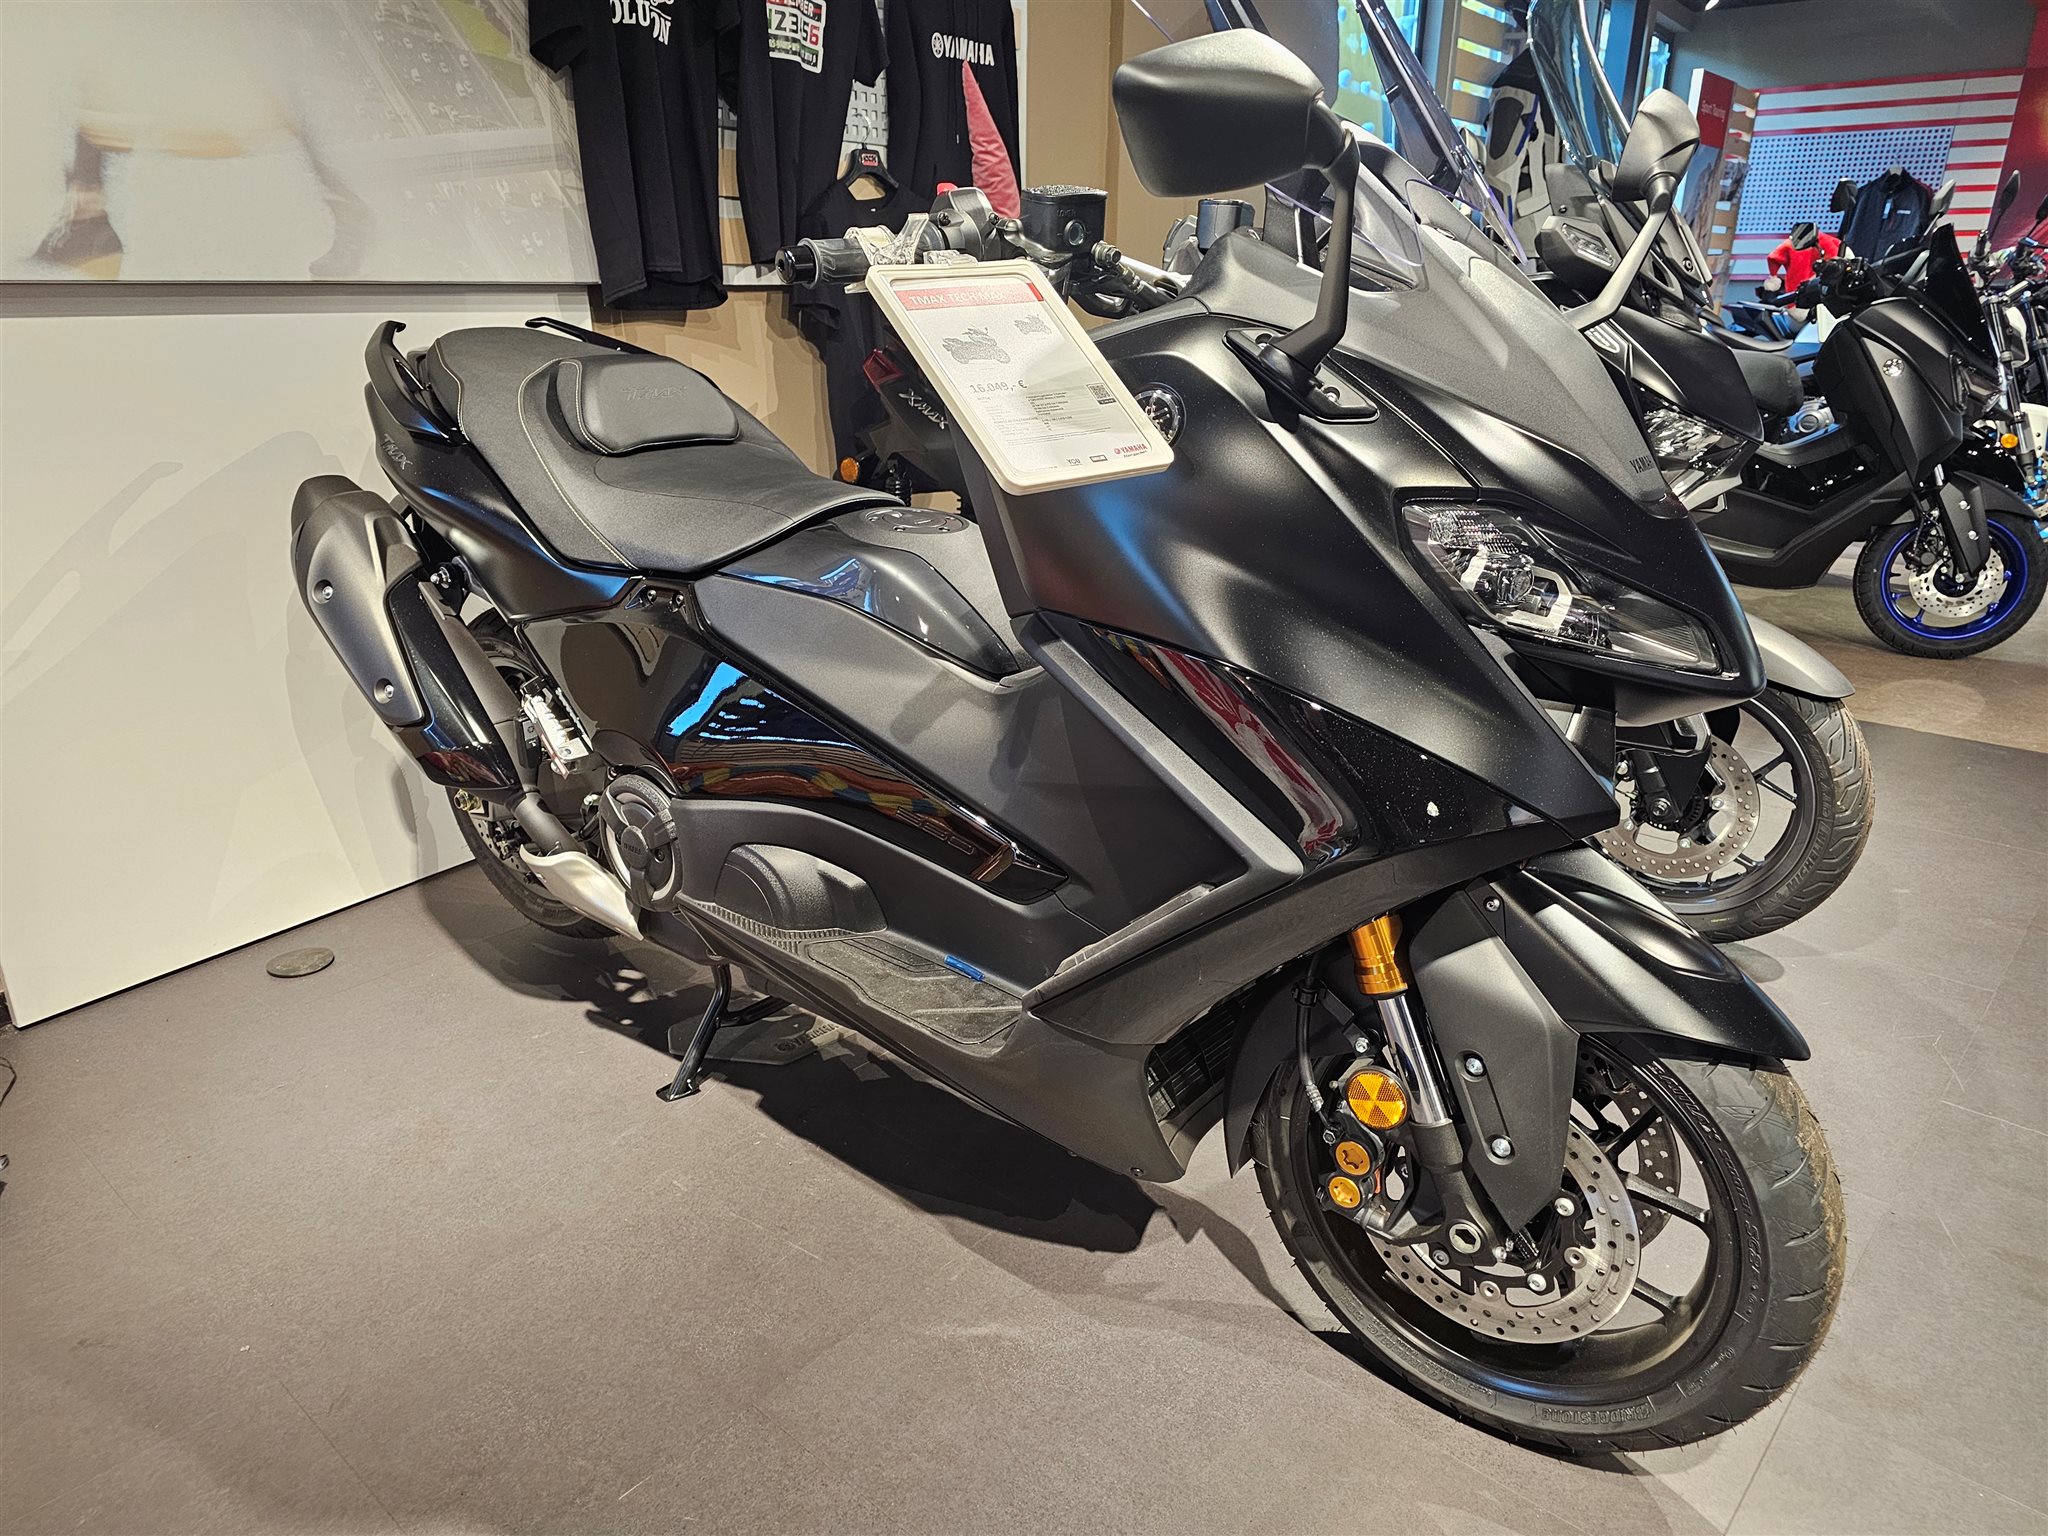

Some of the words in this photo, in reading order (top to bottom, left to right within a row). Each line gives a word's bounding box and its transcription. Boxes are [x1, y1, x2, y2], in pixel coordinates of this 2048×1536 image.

[943, 34, 995, 66] YAMAHA
[908, 294, 946, 306] TMAX
[1120, 443, 1148, 454] YAMAHA
[1785, 826, 1829, 891] MICHELIN
[1541, 1406, 1651, 1426] BRIDGESTONE
